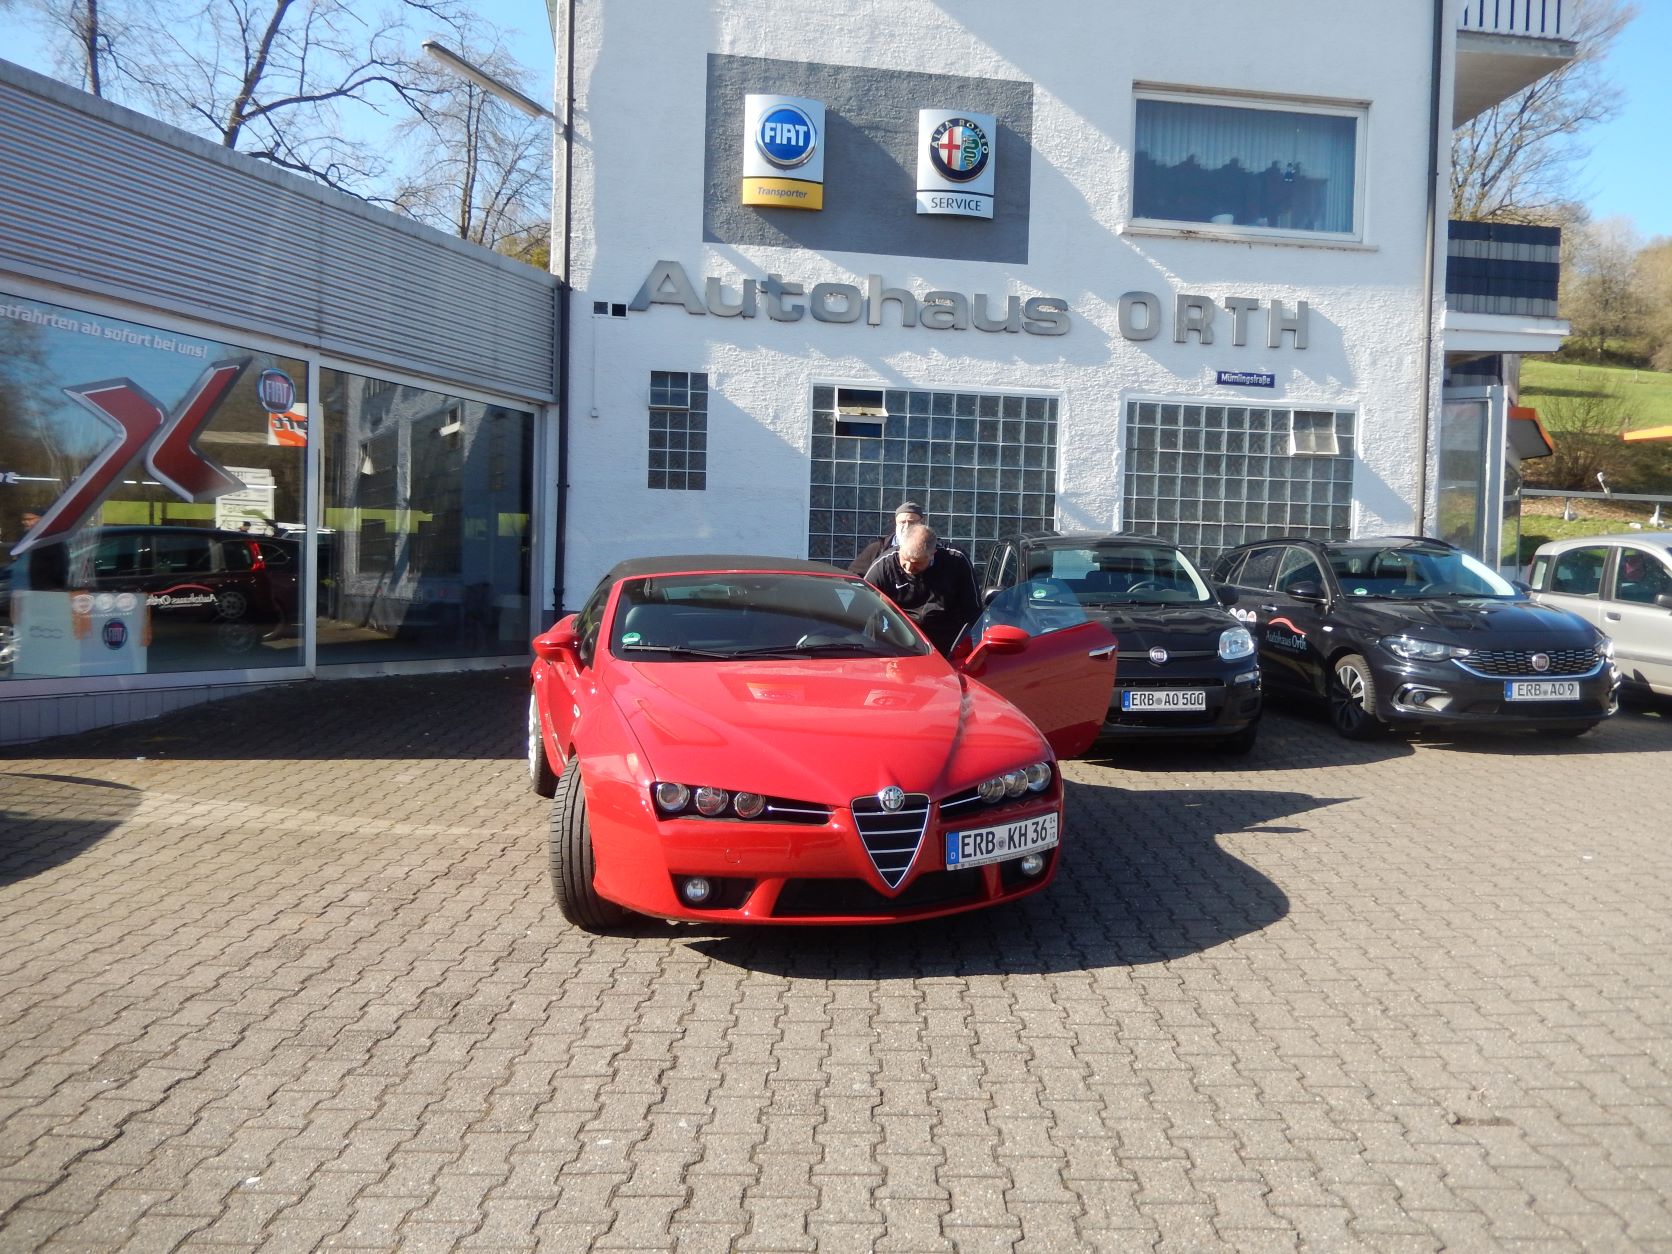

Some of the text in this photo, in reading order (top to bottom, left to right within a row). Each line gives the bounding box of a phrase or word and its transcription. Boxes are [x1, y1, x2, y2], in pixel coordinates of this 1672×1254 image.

[764, 122, 808, 146] FIAT
[931, 119, 990, 154] ALFA ROMEO
[757, 186, 808, 199] Transporter
[931, 197, 982, 212] SERVICE
[628, 260, 1310, 350] Autohaus ORTH
[80, 321, 101, 337] ab
[103, 327, 152, 348] sofort
[153, 335, 176, 352] bei
[177, 345, 208, 359] uns!
[265, 380, 289, 404] FIAT
[1291, 635, 1307, 651] Orth
[1131, 693, 1204, 706] ERB AO 500
[1517, 683, 1574, 696] ERB AO 9
[961, 831, 996, 859] ERB
[1007, 824, 1028, 850] KH
[1031, 819, 1048, 844] 36
